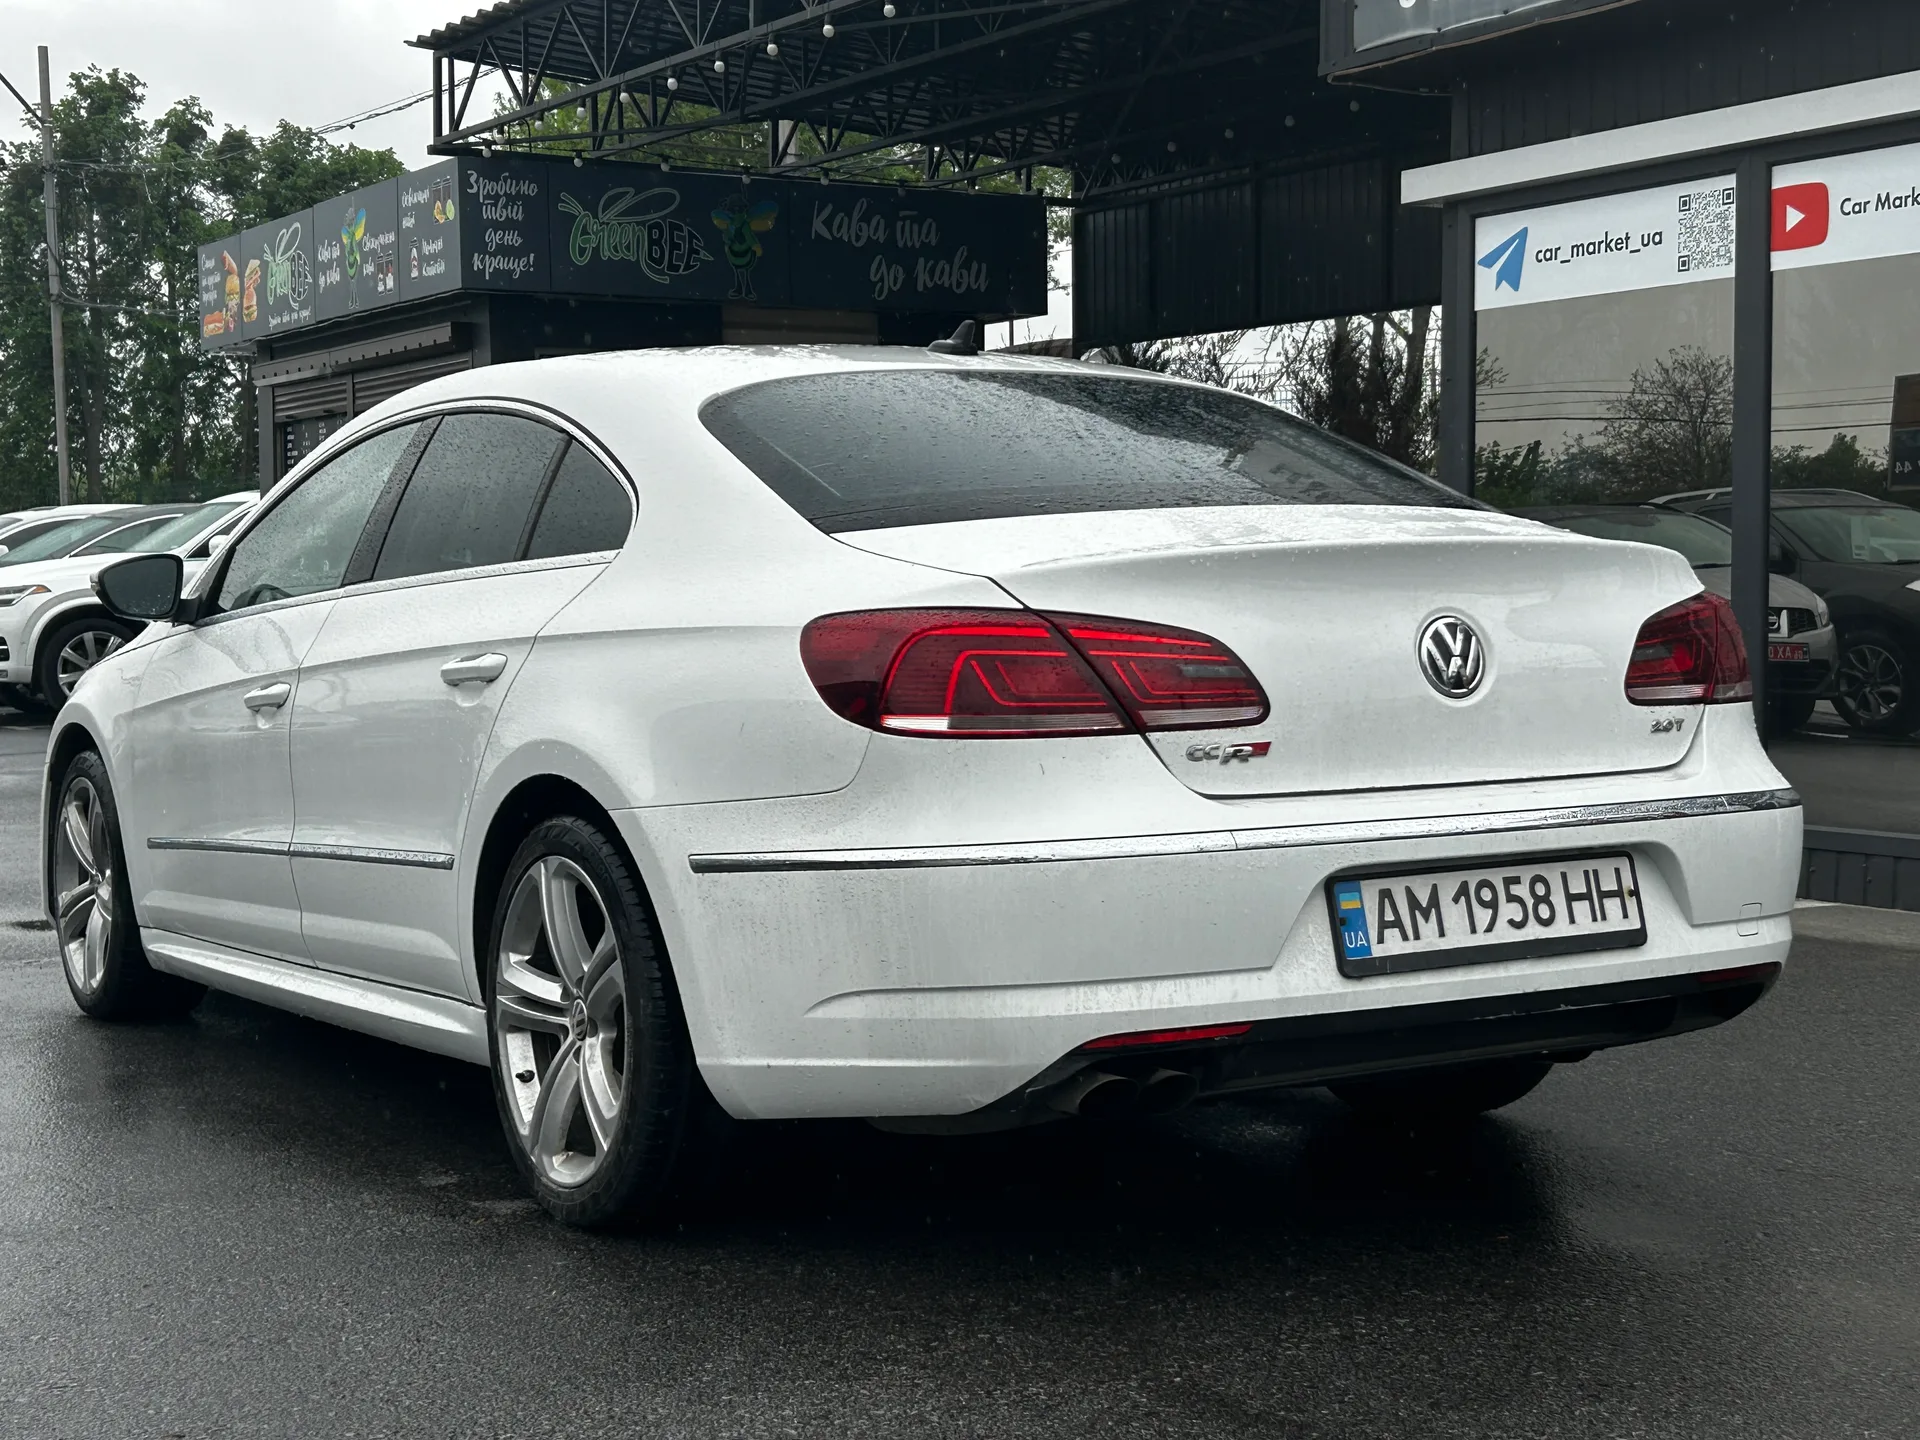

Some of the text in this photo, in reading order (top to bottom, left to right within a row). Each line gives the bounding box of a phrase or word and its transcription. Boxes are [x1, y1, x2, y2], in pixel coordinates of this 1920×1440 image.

[466, 170, 538, 203] Зробимо
[482, 196, 524, 221] твій
[1840, 197, 1871, 216] Car
[811, 198, 940, 248] Кава та
[485, 228, 523, 252] день
[1535, 231, 1664, 264] car_market_ua
[472, 252, 535, 280] краще!
[870, 246, 989, 300] до кави
[1376, 866, 1629, 945] AM 1958 HH
[1344, 930, 1368, 949] UA
